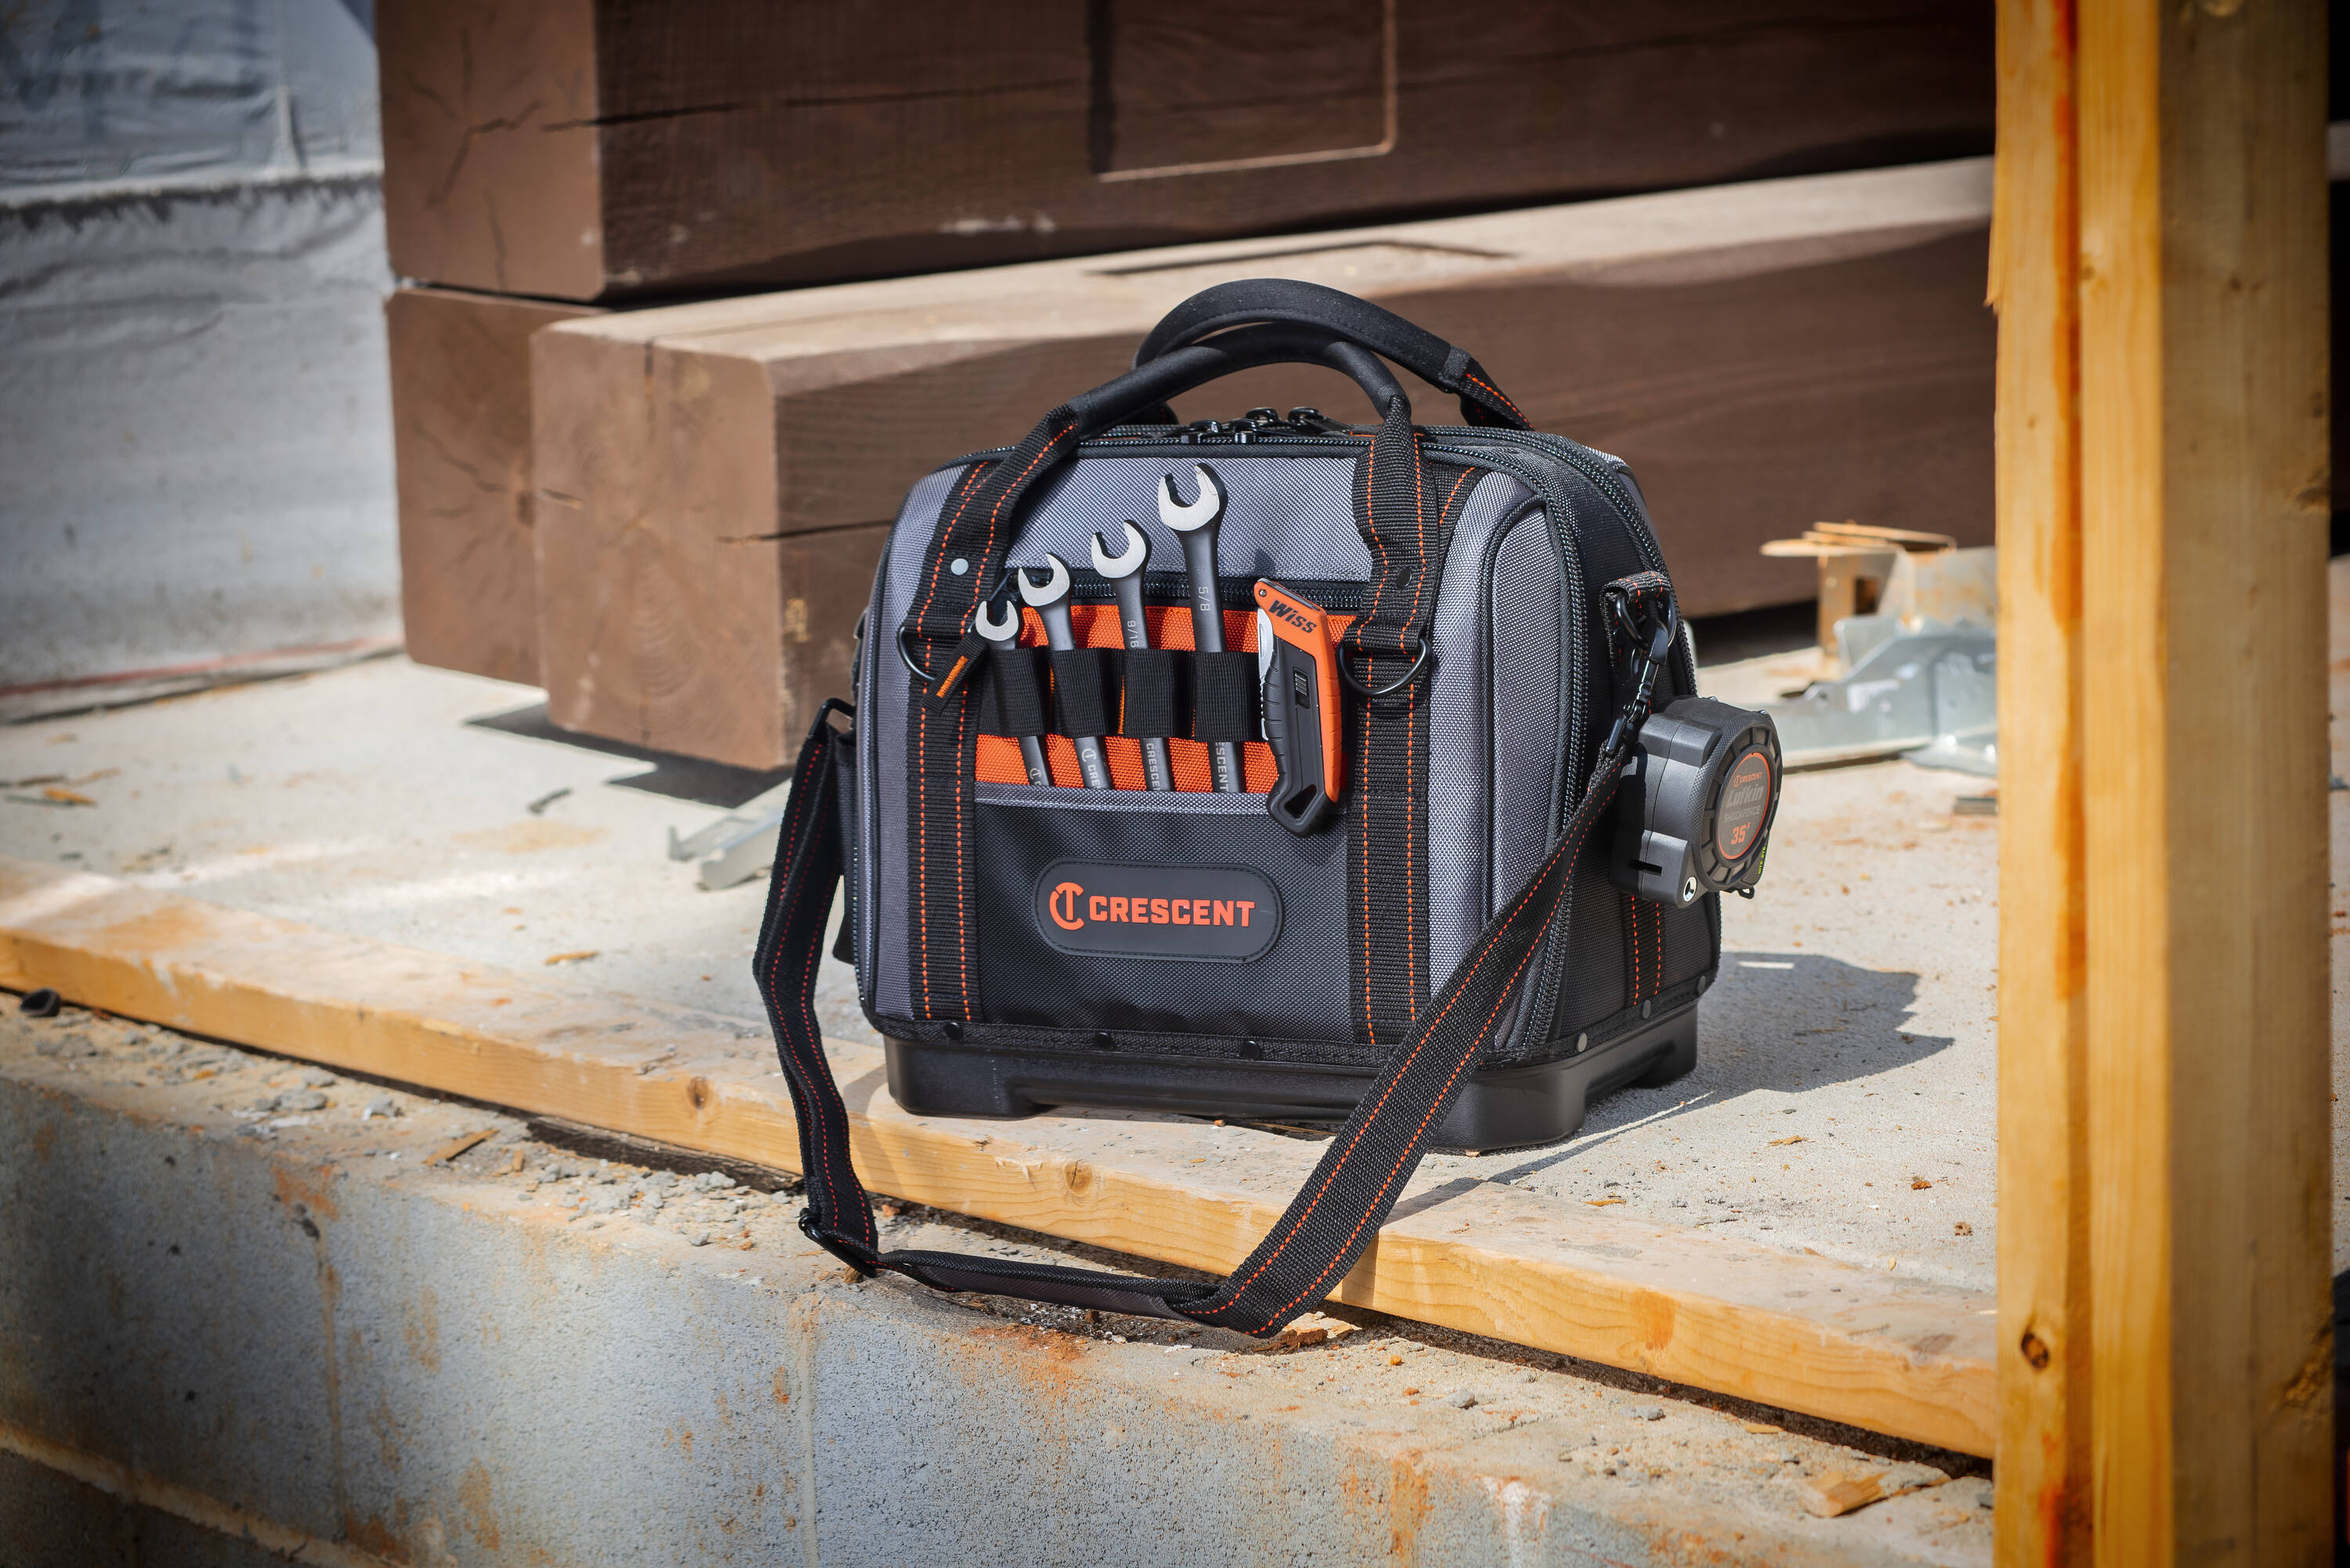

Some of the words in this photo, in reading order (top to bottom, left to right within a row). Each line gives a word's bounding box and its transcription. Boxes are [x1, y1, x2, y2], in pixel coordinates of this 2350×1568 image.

[1198, 586, 1210, 611] 5/8
[1127, 620, 1139, 648] 9/16
[1739, 771, 1763, 784] CRESCENT
[1089, 895, 1255, 927] CRESCENT
